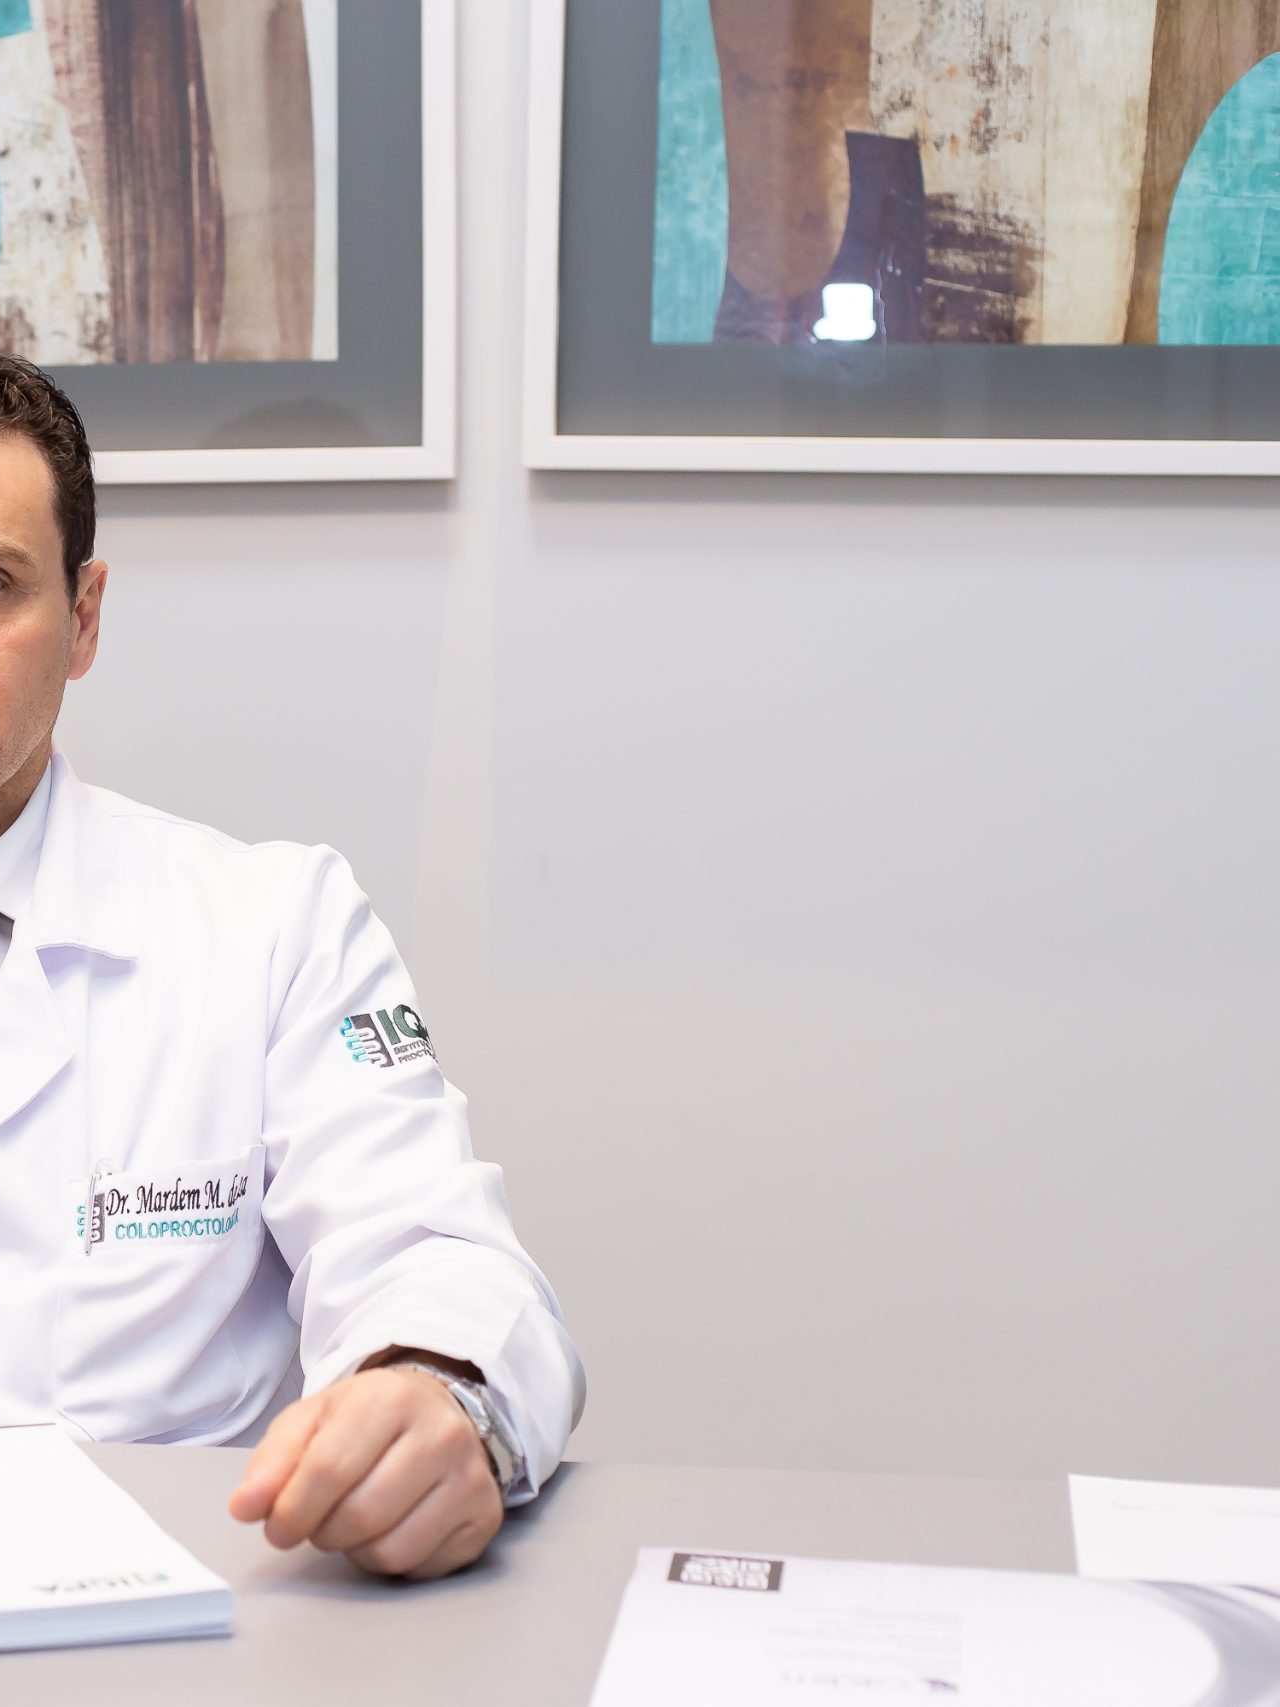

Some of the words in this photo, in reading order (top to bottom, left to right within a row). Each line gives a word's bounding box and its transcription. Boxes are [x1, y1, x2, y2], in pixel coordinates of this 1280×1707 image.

[106, 1188, 131, 1216] Dr.
[136, 1177, 201, 1215] Mardem
[205, 1178, 225, 1211] M.
